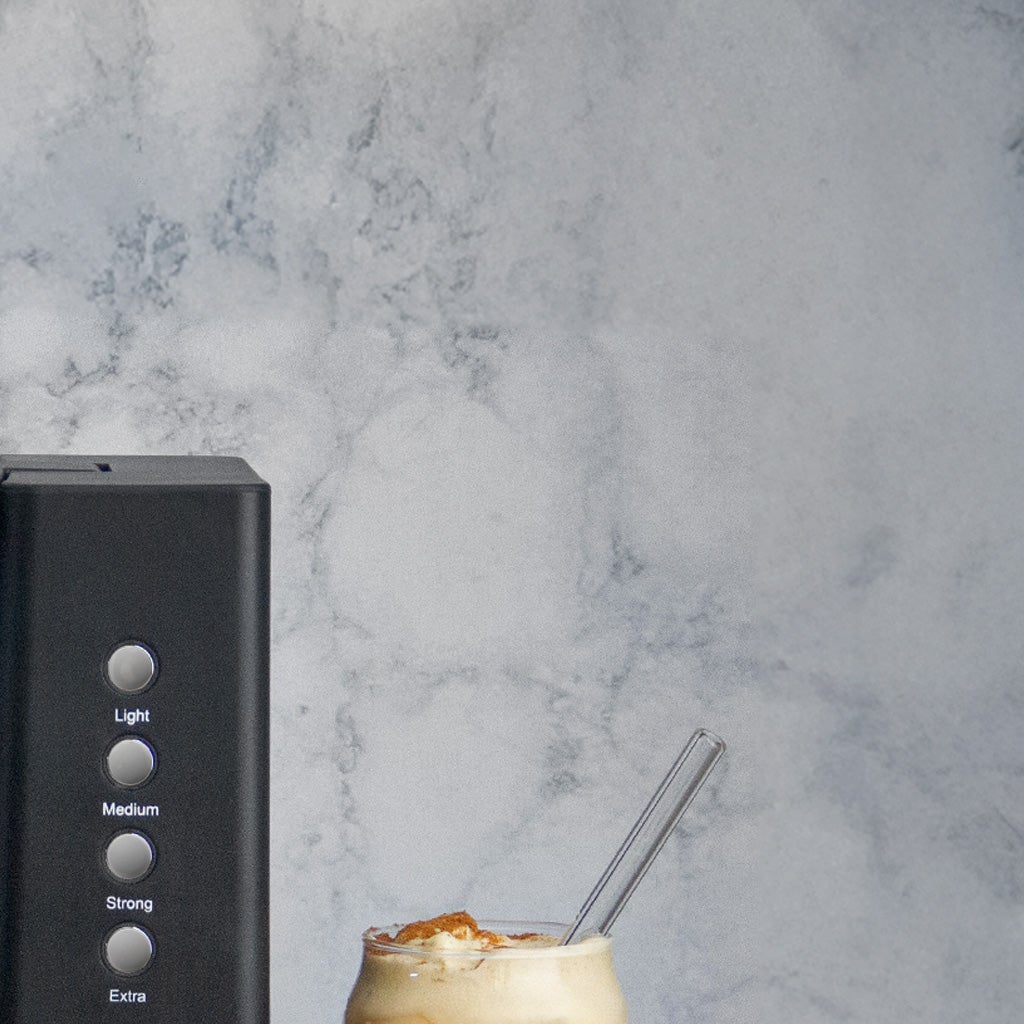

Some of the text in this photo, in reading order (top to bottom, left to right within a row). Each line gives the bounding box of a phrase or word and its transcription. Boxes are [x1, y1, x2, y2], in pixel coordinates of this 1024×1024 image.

[115, 708, 150, 724] Light
[103, 802, 159, 817] Medium
[106, 896, 153, 912] Strong
[109, 989, 147, 1003] Extra
